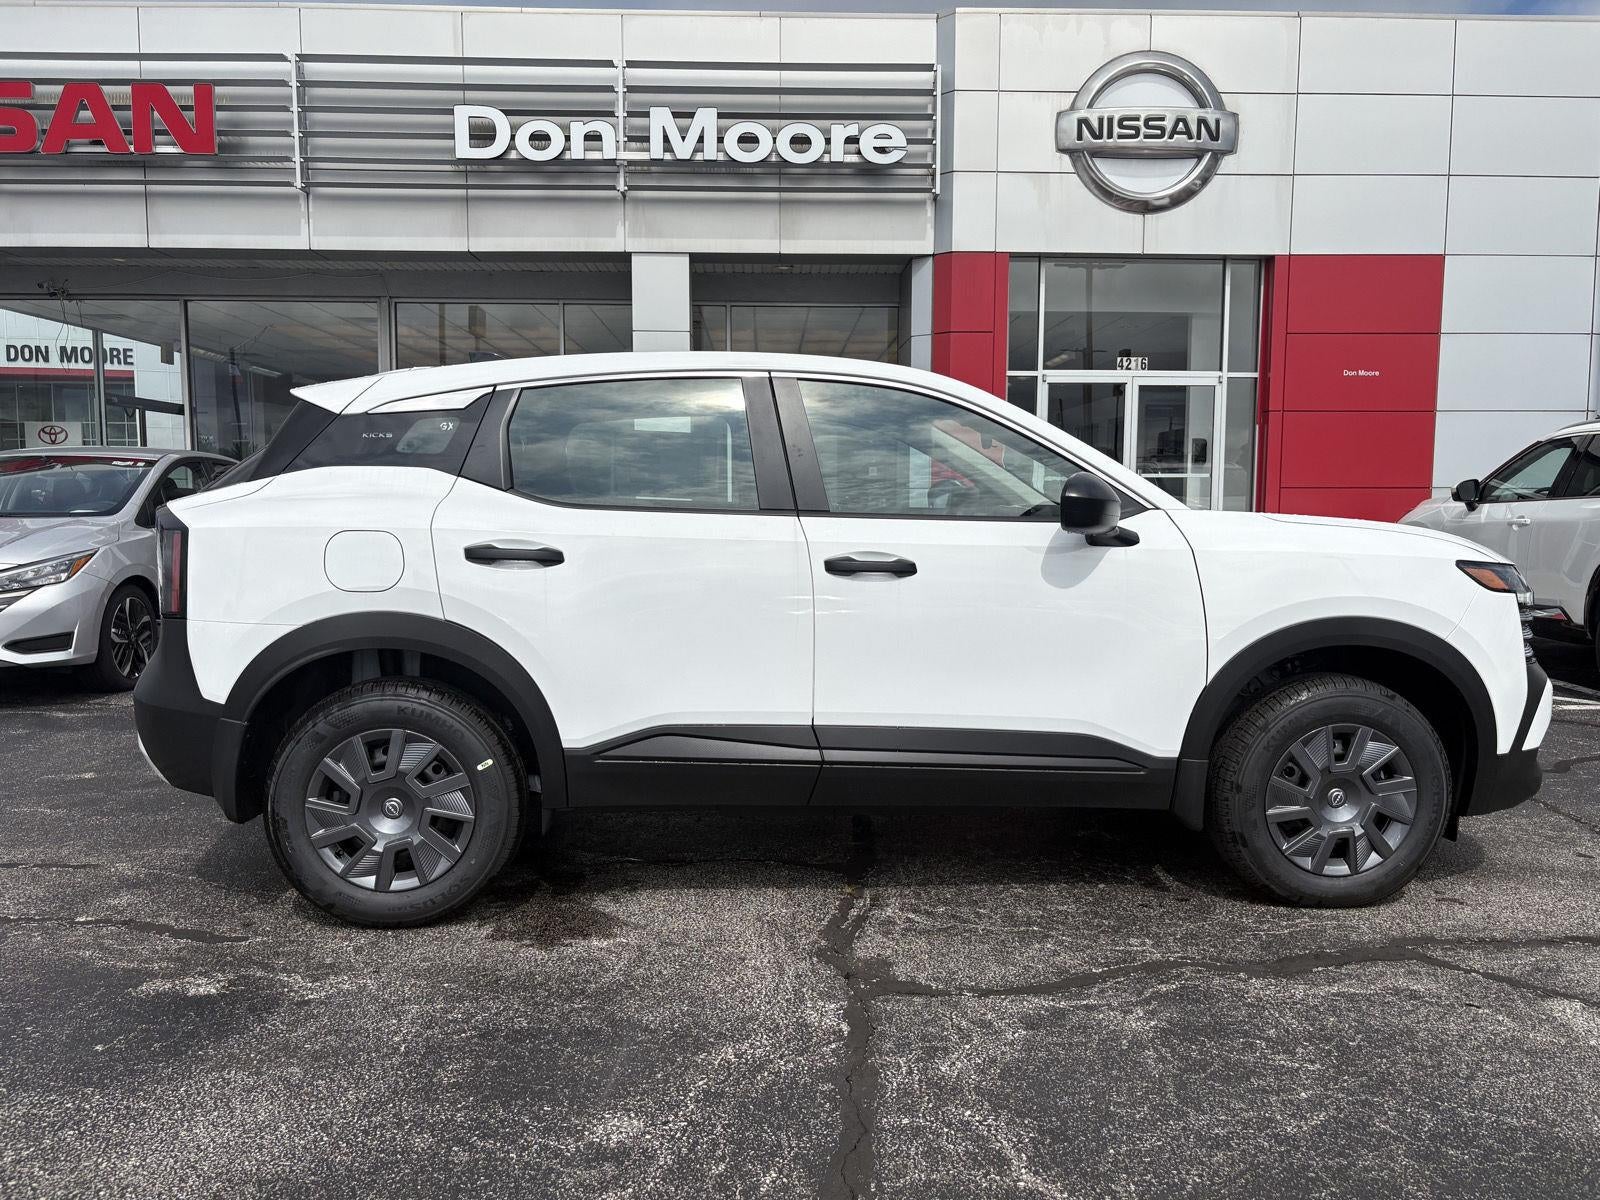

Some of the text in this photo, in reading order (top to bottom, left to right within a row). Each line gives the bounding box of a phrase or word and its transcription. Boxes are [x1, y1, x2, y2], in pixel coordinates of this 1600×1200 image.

[453, 104, 908, 164] Don Moore
[1076, 116, 1221, 142] NISSAN
[6, 344, 49, 363] DON
[1117, 357, 1147, 371] 4216
[1358, 369, 1379, 377] Moore
